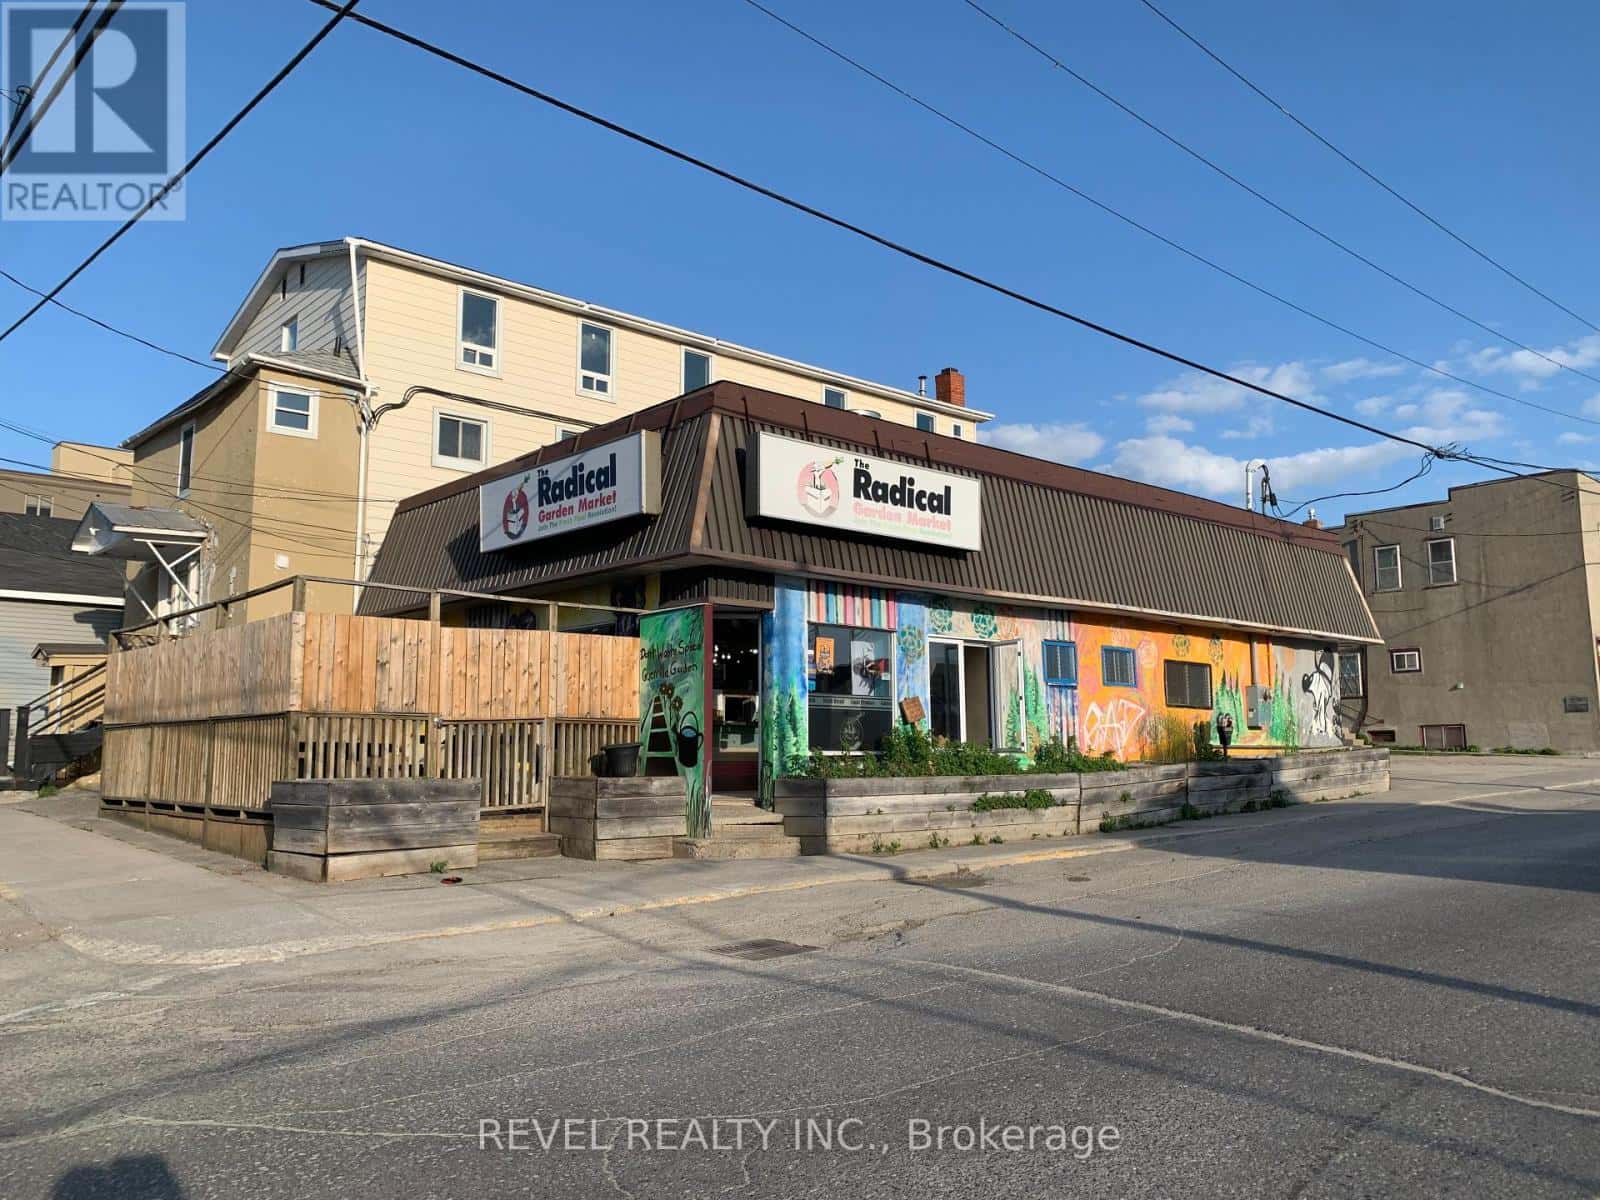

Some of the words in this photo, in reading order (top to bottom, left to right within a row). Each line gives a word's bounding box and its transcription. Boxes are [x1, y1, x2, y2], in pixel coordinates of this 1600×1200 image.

[537, 469, 548, 478] The
[854, 458, 870, 470] The
[537, 453, 617, 507] Radical
[853, 469, 952, 515] Radical
[538, 503, 574, 523] Garden
[577, 490, 617, 513] Market
[853, 502, 902, 523] Garden
[906, 510, 952, 532] Market
